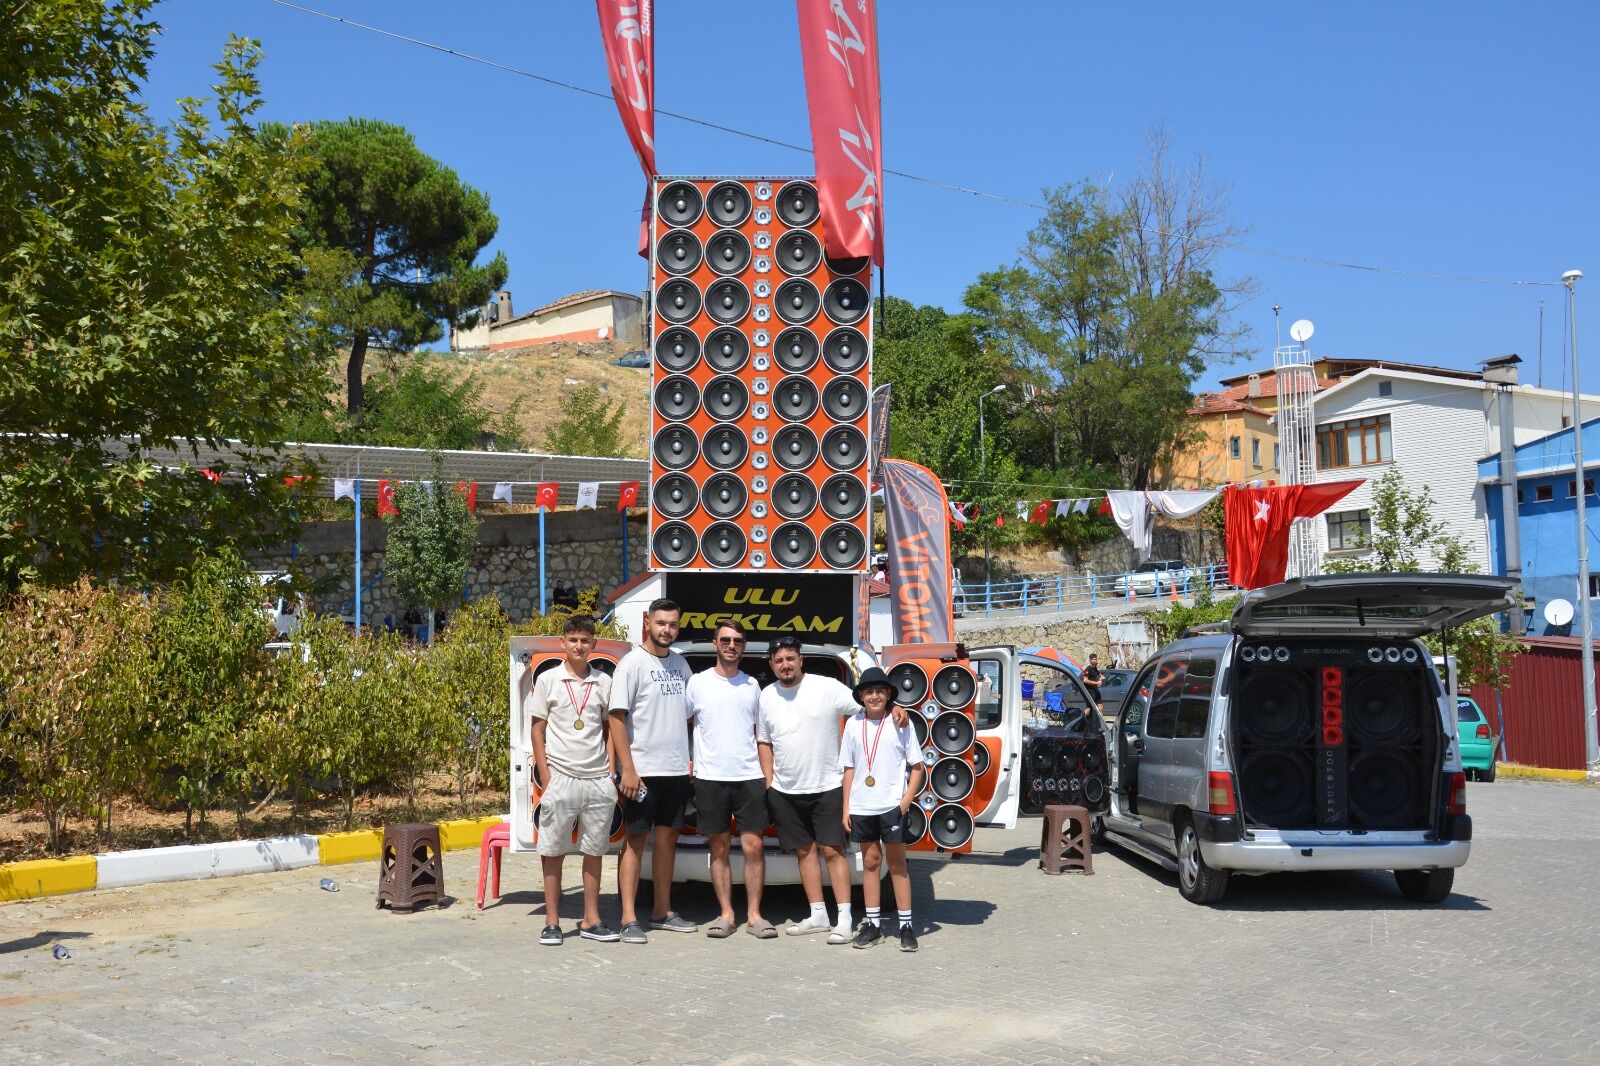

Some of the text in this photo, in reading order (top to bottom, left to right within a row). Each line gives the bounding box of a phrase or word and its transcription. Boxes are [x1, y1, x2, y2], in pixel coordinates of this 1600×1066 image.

[723, 587, 801, 605] ULU
[680, 612, 844, 632] REKLAM
[660, 682, 683, 696] CAMP
